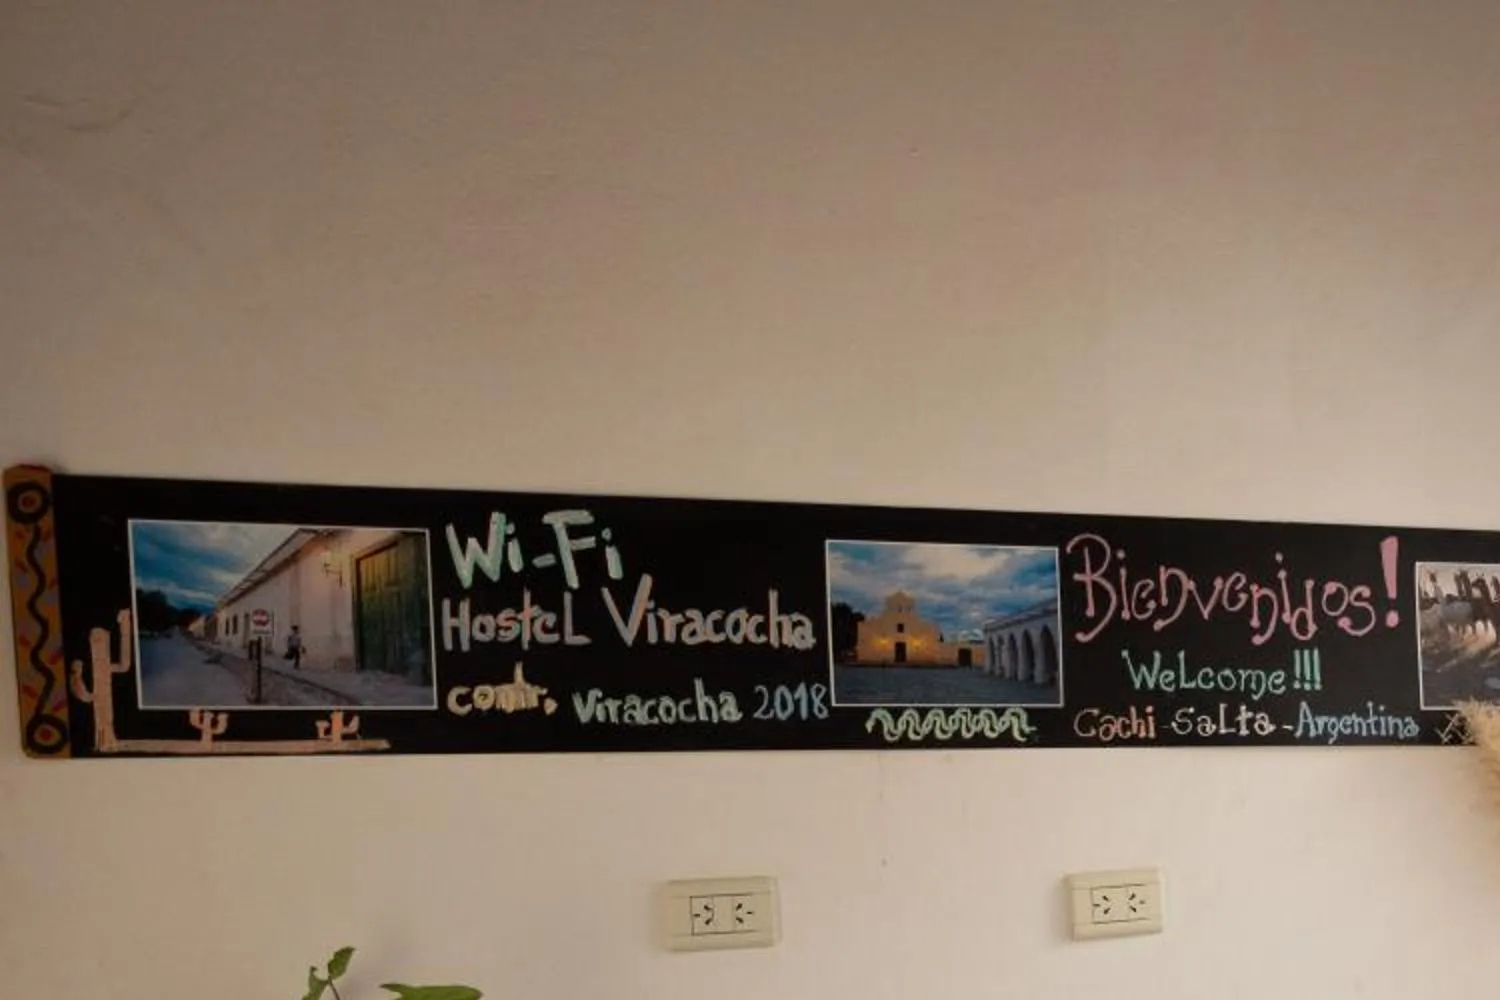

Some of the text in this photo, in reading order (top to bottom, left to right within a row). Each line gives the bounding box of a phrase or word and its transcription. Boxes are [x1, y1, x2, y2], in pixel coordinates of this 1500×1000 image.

[446, 509, 623, 589] Wi-Fi
[602, 573, 817, 649] Viracocha
[1066, 533, 1400, 645] Bienvenidos!
[753, 682, 829, 720] 2018
